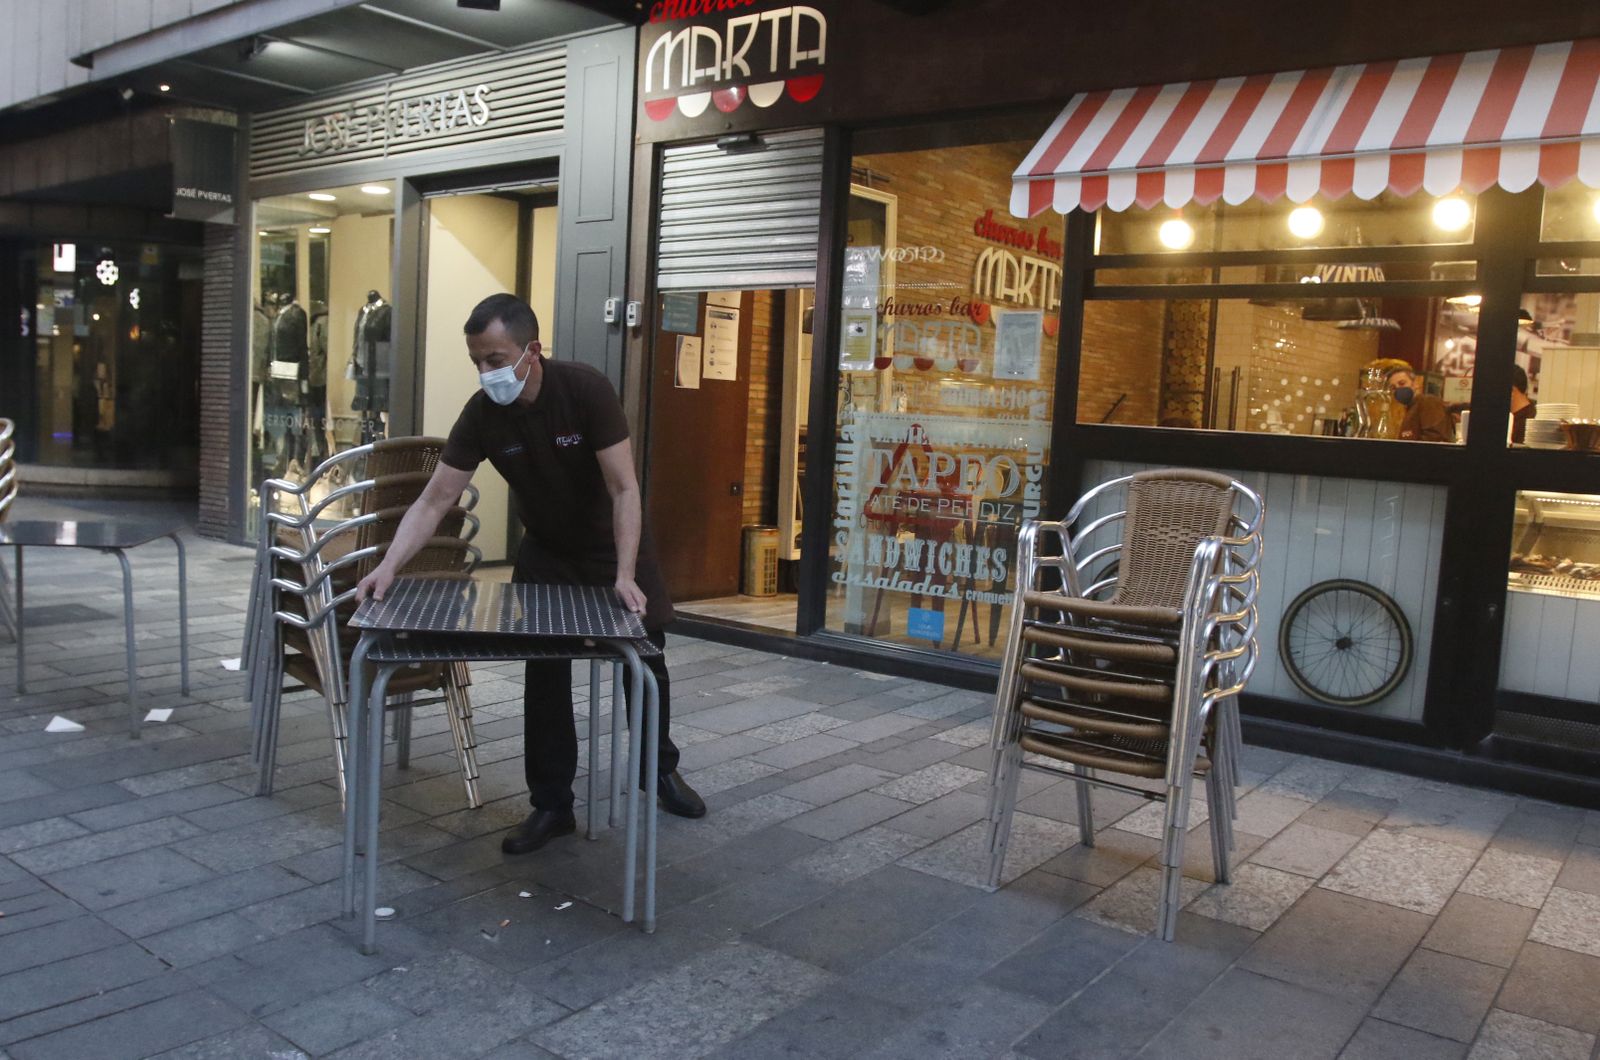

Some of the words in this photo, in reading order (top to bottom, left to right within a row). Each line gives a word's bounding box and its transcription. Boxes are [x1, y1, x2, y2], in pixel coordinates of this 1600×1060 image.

[645, 6, 827, 93] MARTA
[976, 246, 1063, 310] MARTA
[877, 296, 942, 317] churros
[949, 296, 983, 316] bar
[907, 498, 932, 513] DE
[835, 529, 1008, 583] SANDWICHES
[831, 571, 962, 601] ensaladas
